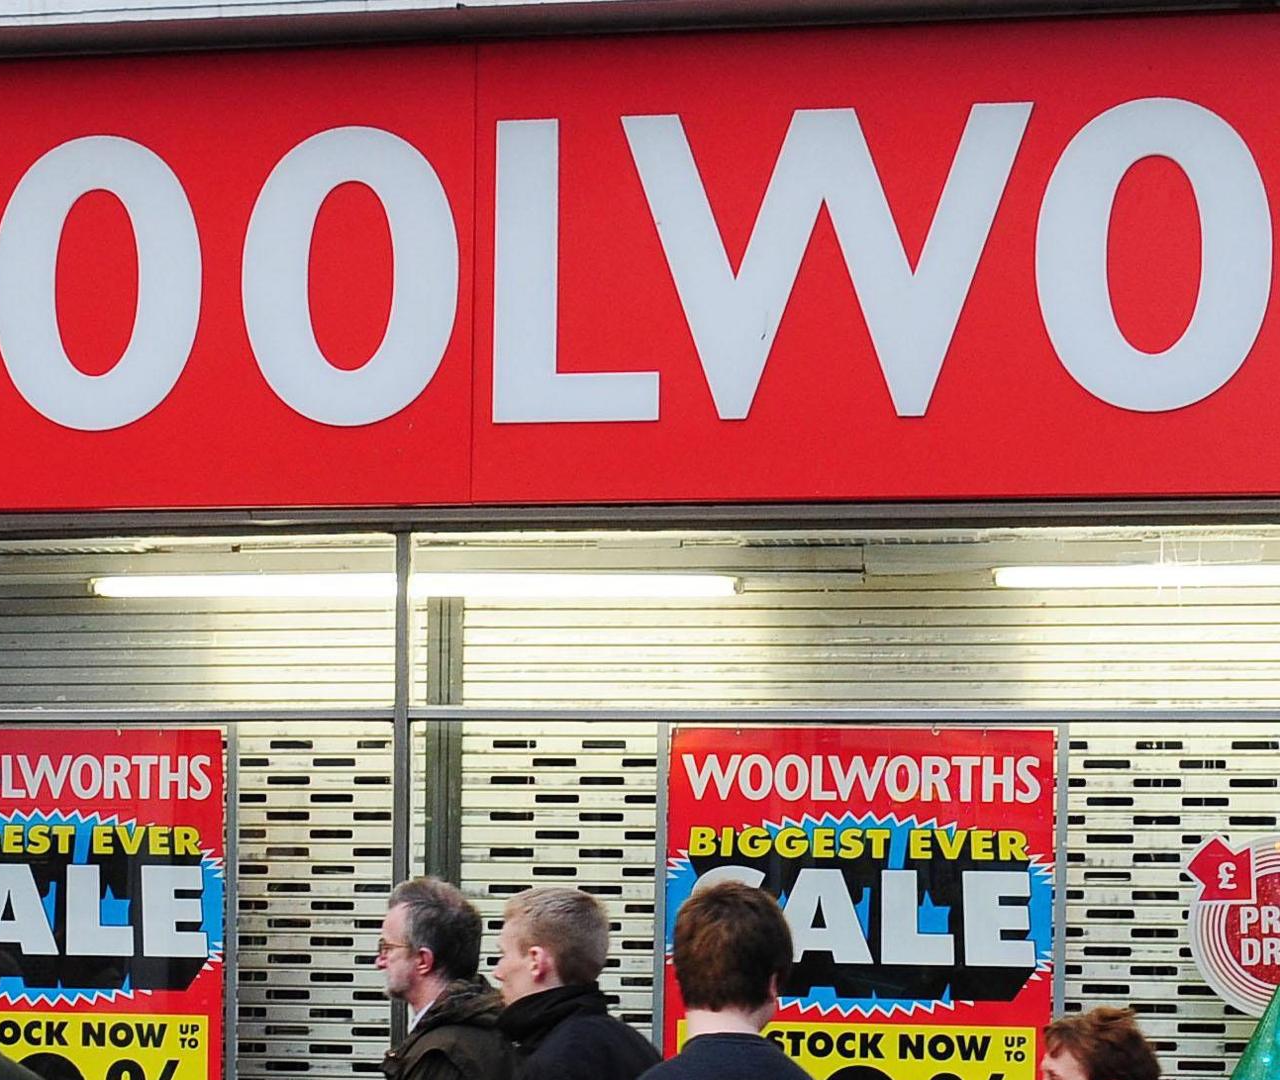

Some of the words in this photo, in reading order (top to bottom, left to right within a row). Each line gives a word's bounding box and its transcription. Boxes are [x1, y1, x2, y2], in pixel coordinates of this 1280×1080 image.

[681, 753, 1042, 804] WOOLWORTHS
[92, 826, 202, 856] EVER
[689, 826, 890, 859] BIGGEST
[909, 829, 1029, 861] EVER
[81, 1022, 168, 1048] NOW
[179, 1023, 200, 1035] UP
[1004, 1036, 1027, 1048] UP
[180, 1038, 199, 1049] TO
[898, 1033, 992, 1062] NOW
[1005, 1050, 1026, 1062] TO
